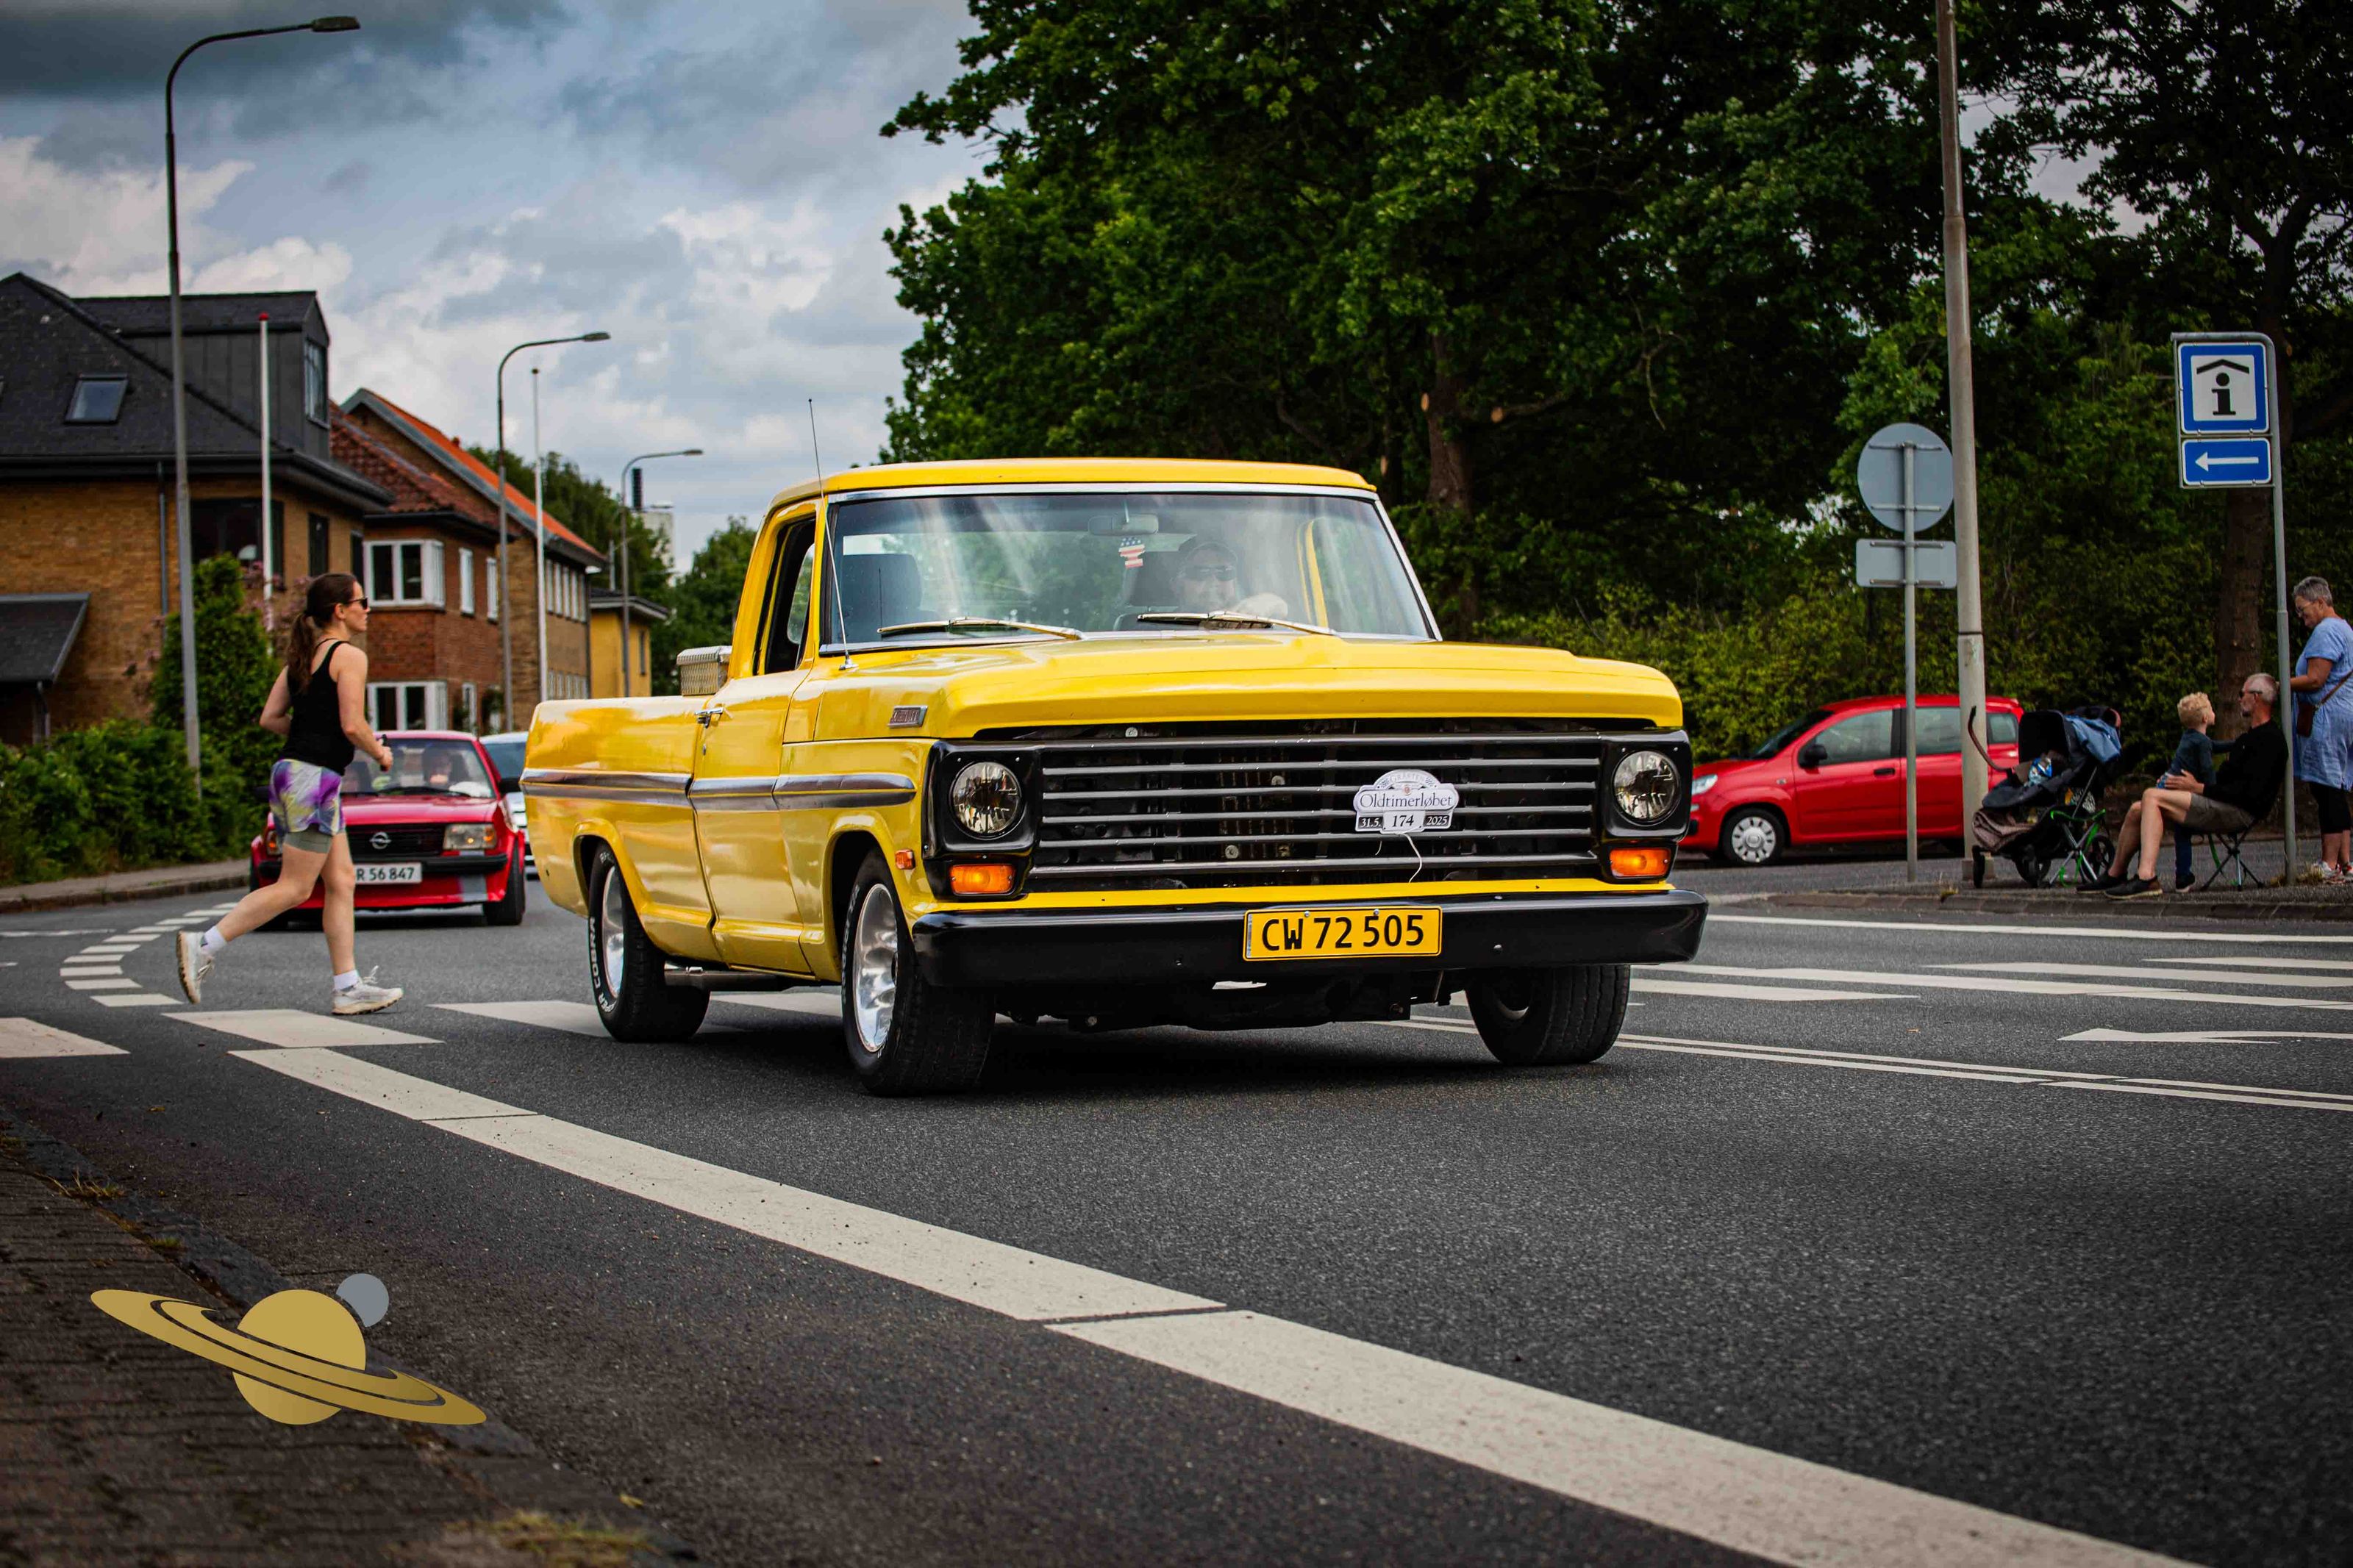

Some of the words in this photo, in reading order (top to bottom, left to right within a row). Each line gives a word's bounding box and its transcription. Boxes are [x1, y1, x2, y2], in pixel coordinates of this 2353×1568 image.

[1360, 792, 1452, 809] Oldtimerløbet
[1361, 817, 1382, 828] 31.5.
[1391, 815, 1415, 828] 174
[1427, 816, 1448, 826] 2025
[356, 867, 365, 881] R
[369, 868, 386, 881] 56
[389, 867, 415, 880] 847
[1262, 918, 1304, 951] CW
[1313, 917, 1352, 949] 72
[1363, 914, 1424, 948] 505
